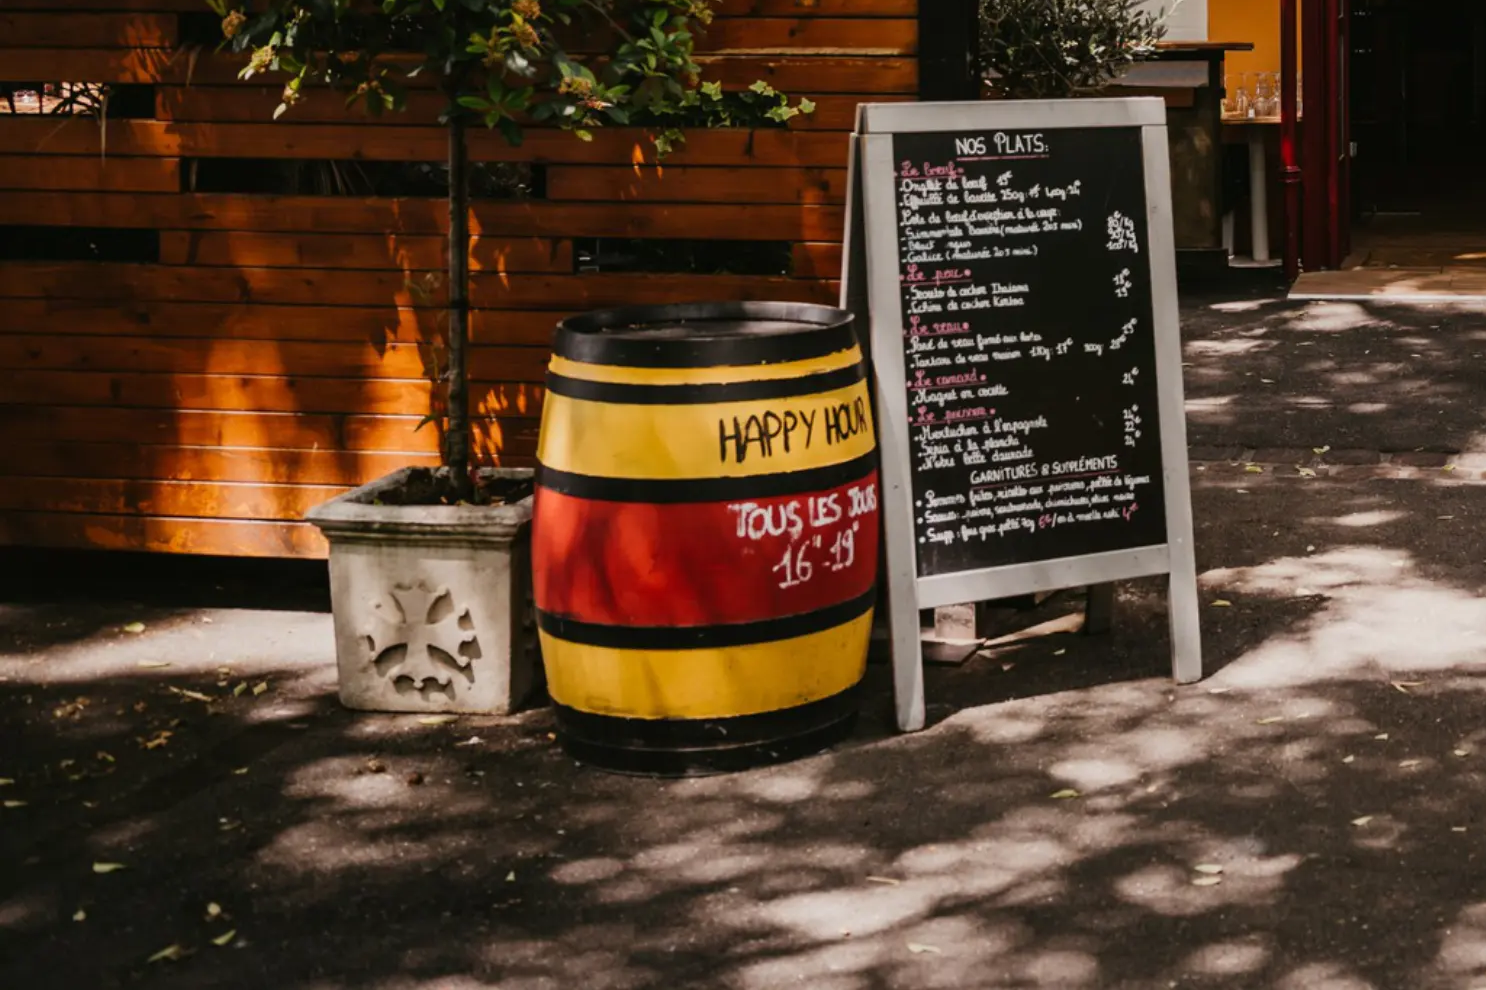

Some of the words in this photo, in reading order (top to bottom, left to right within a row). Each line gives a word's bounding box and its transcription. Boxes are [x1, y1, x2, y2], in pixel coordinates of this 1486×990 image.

[955, 137, 986, 155] NOS
[994, 132, 1049, 154] PLATS:
[901, 160, 919, 177] Le
[902, 178, 942, 197] Onglet
[945, 178, 959, 190] de
[947, 193, 960, 205] de
[928, 212, 941, 224] de
[906, 263, 926, 281] Le
[947, 286, 958, 298] de
[947, 298, 959, 311] de
[910, 315, 929, 334] Le
[937, 337, 949, 350] de
[951, 337, 975, 349] veau
[954, 352, 967, 364] de
[914, 370, 932, 387] Le
[936, 368, 977, 386] canard
[917, 405, 934, 422] Le
[718, 409, 816, 465] HAPPY
[824, 395, 868, 446] HOUR
[982, 421, 991, 435] à
[954, 440, 963, 453] à
[967, 438, 978, 451] la
[970, 461, 1038, 484] GARNITURES
[1052, 454, 1118, 475] SUPPLÉMENTS
[727, 499, 803, 541] TOUS
[808, 492, 842, 527] LES
